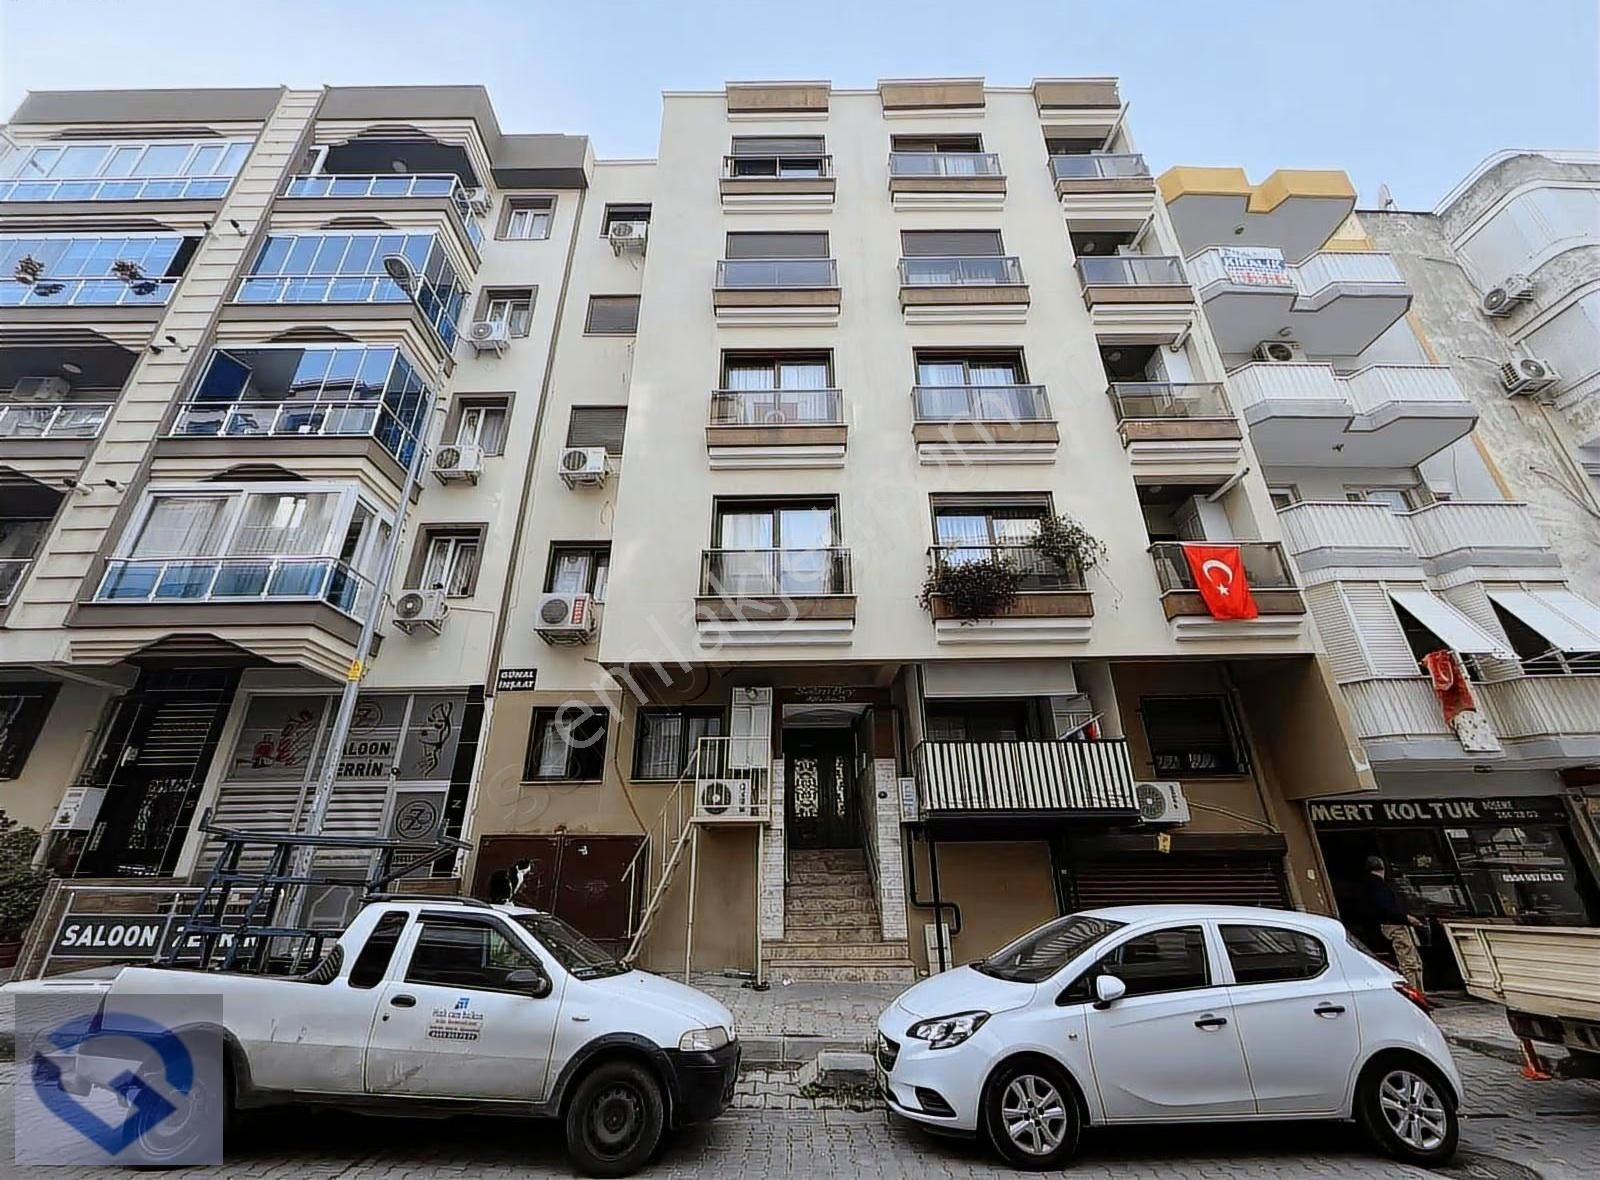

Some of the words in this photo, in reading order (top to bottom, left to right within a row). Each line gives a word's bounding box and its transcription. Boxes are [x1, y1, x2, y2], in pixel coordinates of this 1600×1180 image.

[342, 741, 392, 756] LOON
[336, 759, 384, 777] ERRİN
[1311, 803, 1375, 821] MERT
[1383, 801, 1480, 820] KOLTUK
[61, 924, 159, 947] SALOON
